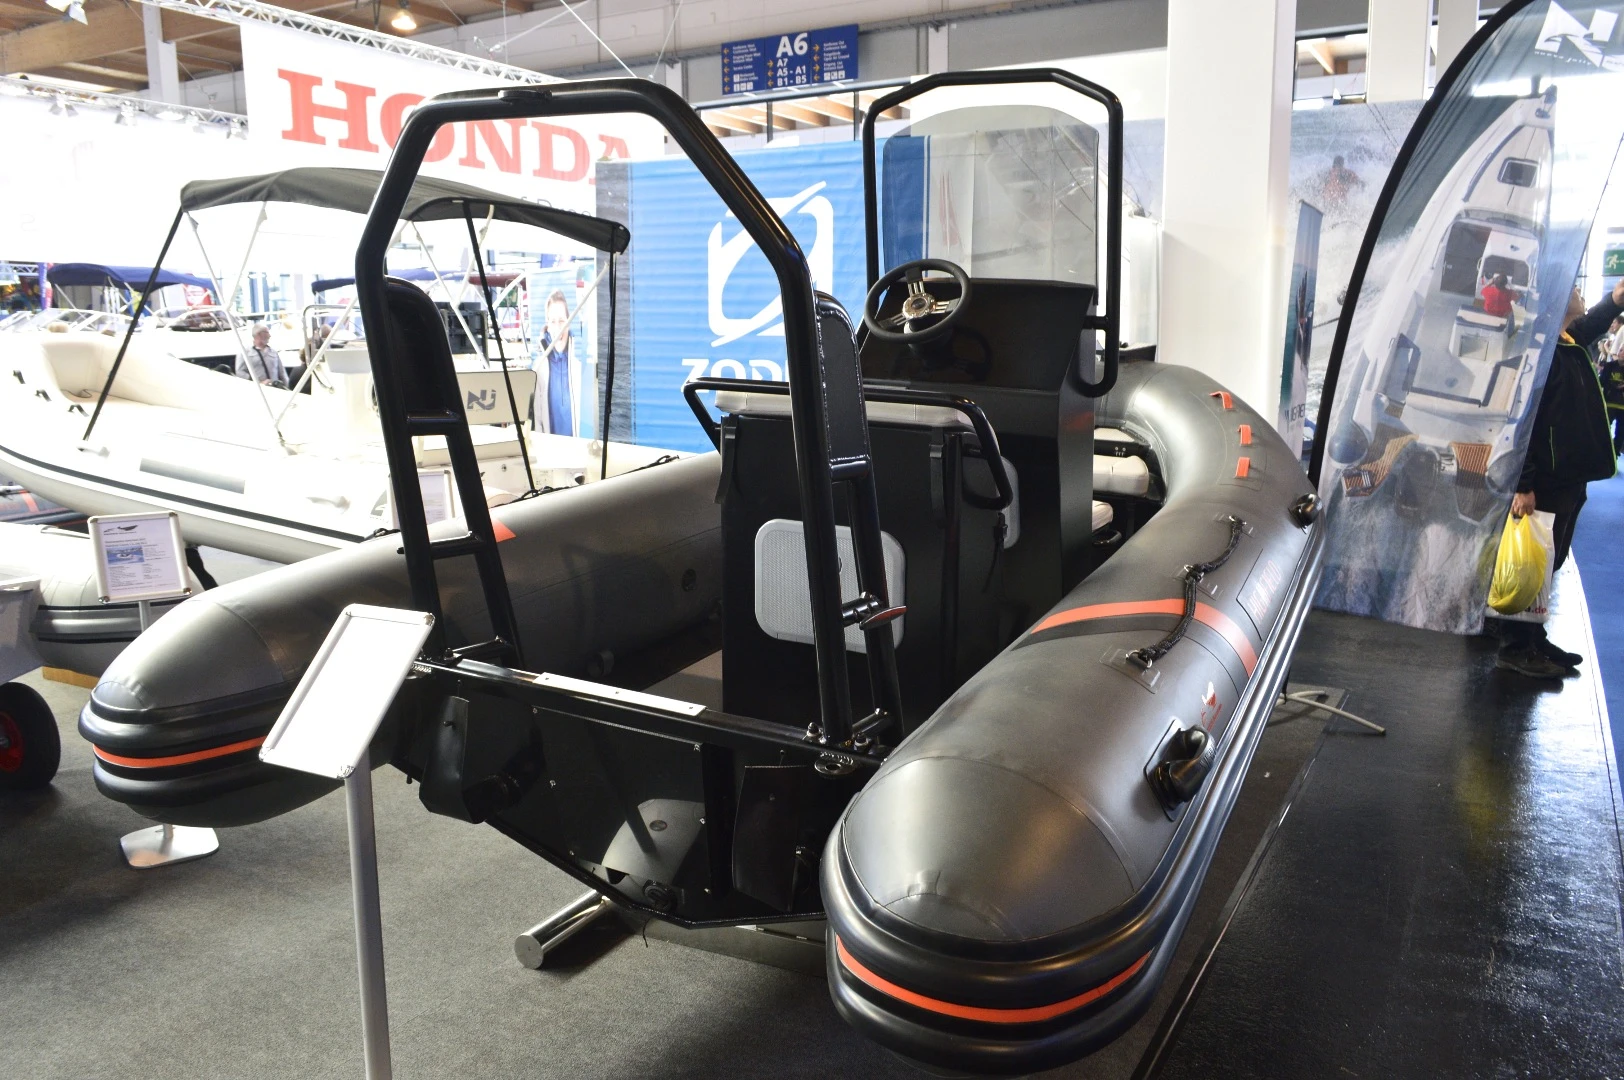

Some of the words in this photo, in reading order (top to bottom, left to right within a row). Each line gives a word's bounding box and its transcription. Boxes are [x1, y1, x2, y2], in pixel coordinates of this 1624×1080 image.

[776, 32, 808, 58] A6
[777, 58, 788, 67] A7
[777, 67, 788, 77] A5
[795, 65, 806, 75] A1
[777, 77, 788, 87] B1
[796, 75, 807, 84] B5
